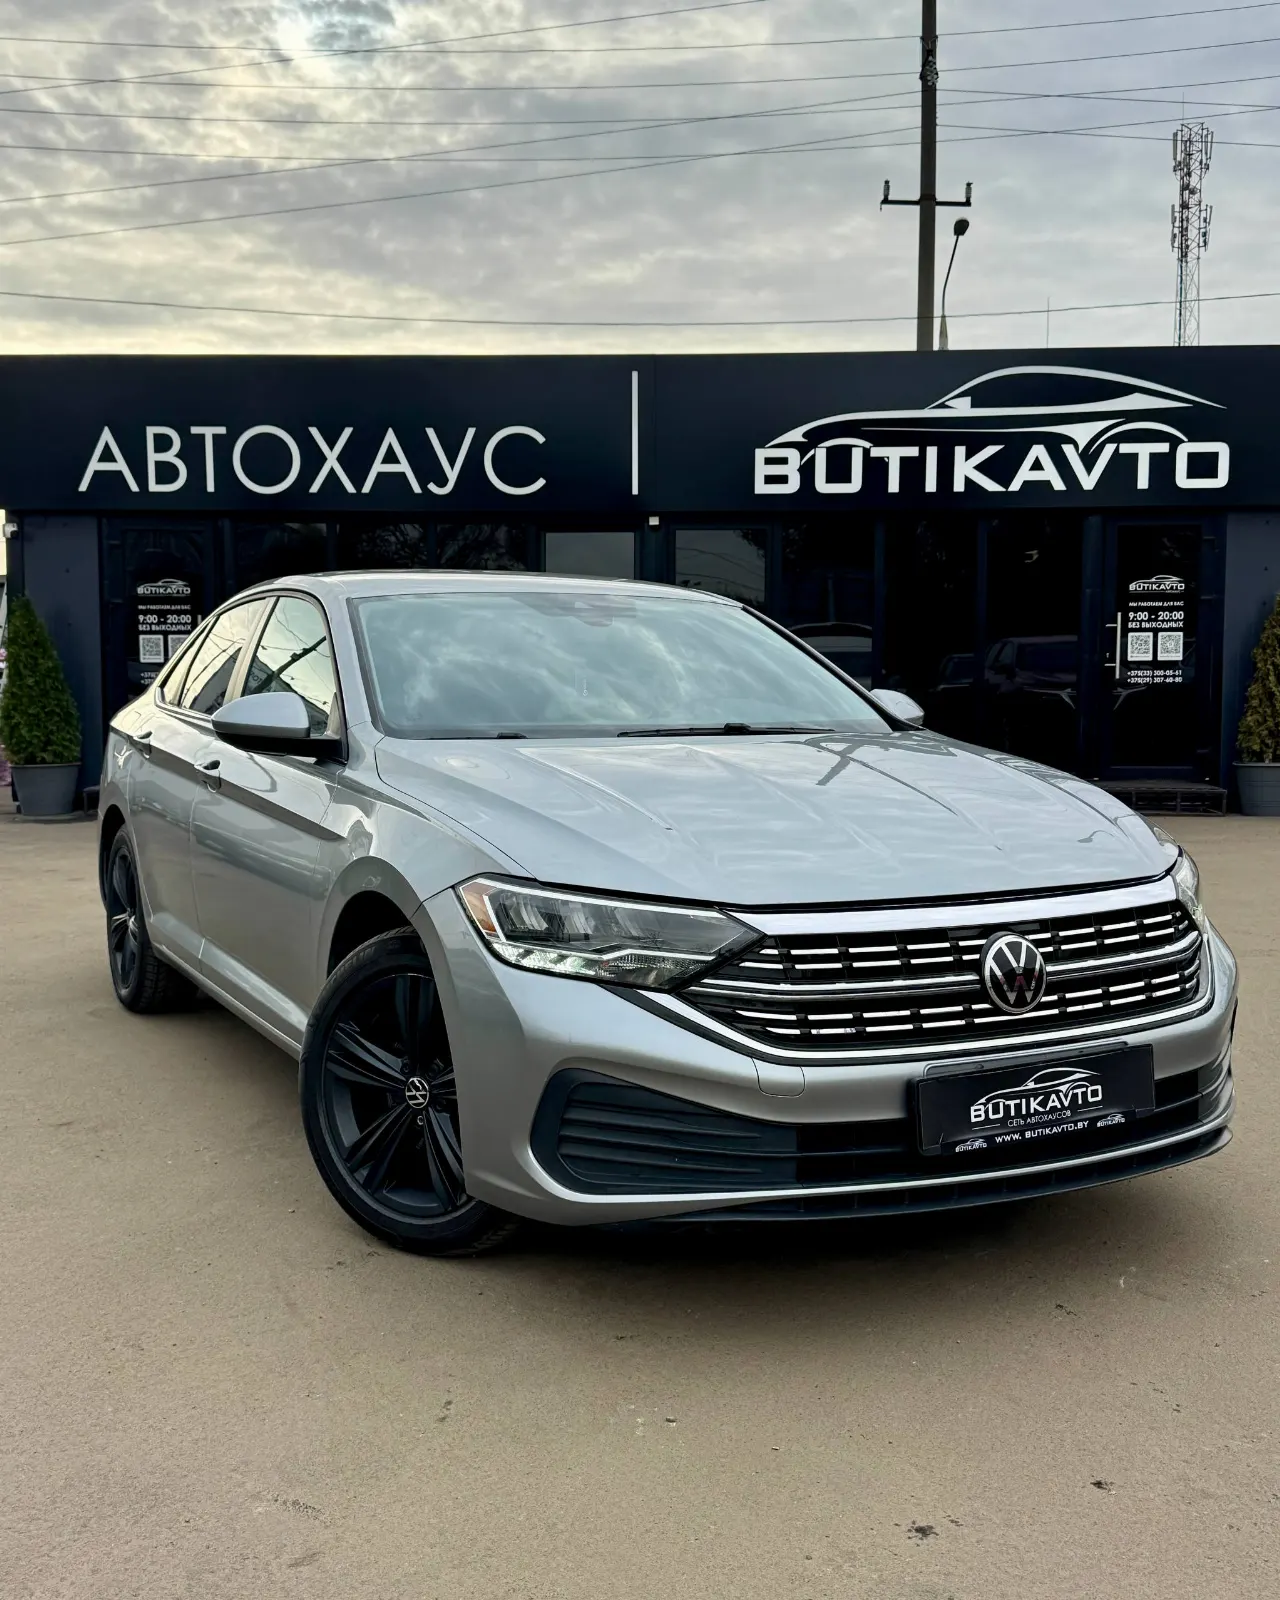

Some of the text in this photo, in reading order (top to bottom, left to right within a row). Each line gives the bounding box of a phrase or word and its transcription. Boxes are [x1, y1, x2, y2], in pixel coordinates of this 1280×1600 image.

[79, 424, 547, 496] АВТОХАУС
[754, 441, 1230, 495] BUTIKAVTO
[1129, 583, 1185, 591] BUTIKAVTO
[138, 615, 158, 623] 9:00
[167, 615, 191, 623] 20:00
[1129, 612, 1148, 620] 9:00
[1158, 611, 1184, 620] 20:00
[970, 1085, 1103, 1122] BUTIKAVTO
[1008, 1110, 1071, 1127] СЕТЬ АВТОХАУСОВ
[1025, 1121, 1089, 1138] BUTIKAVTO.BY
